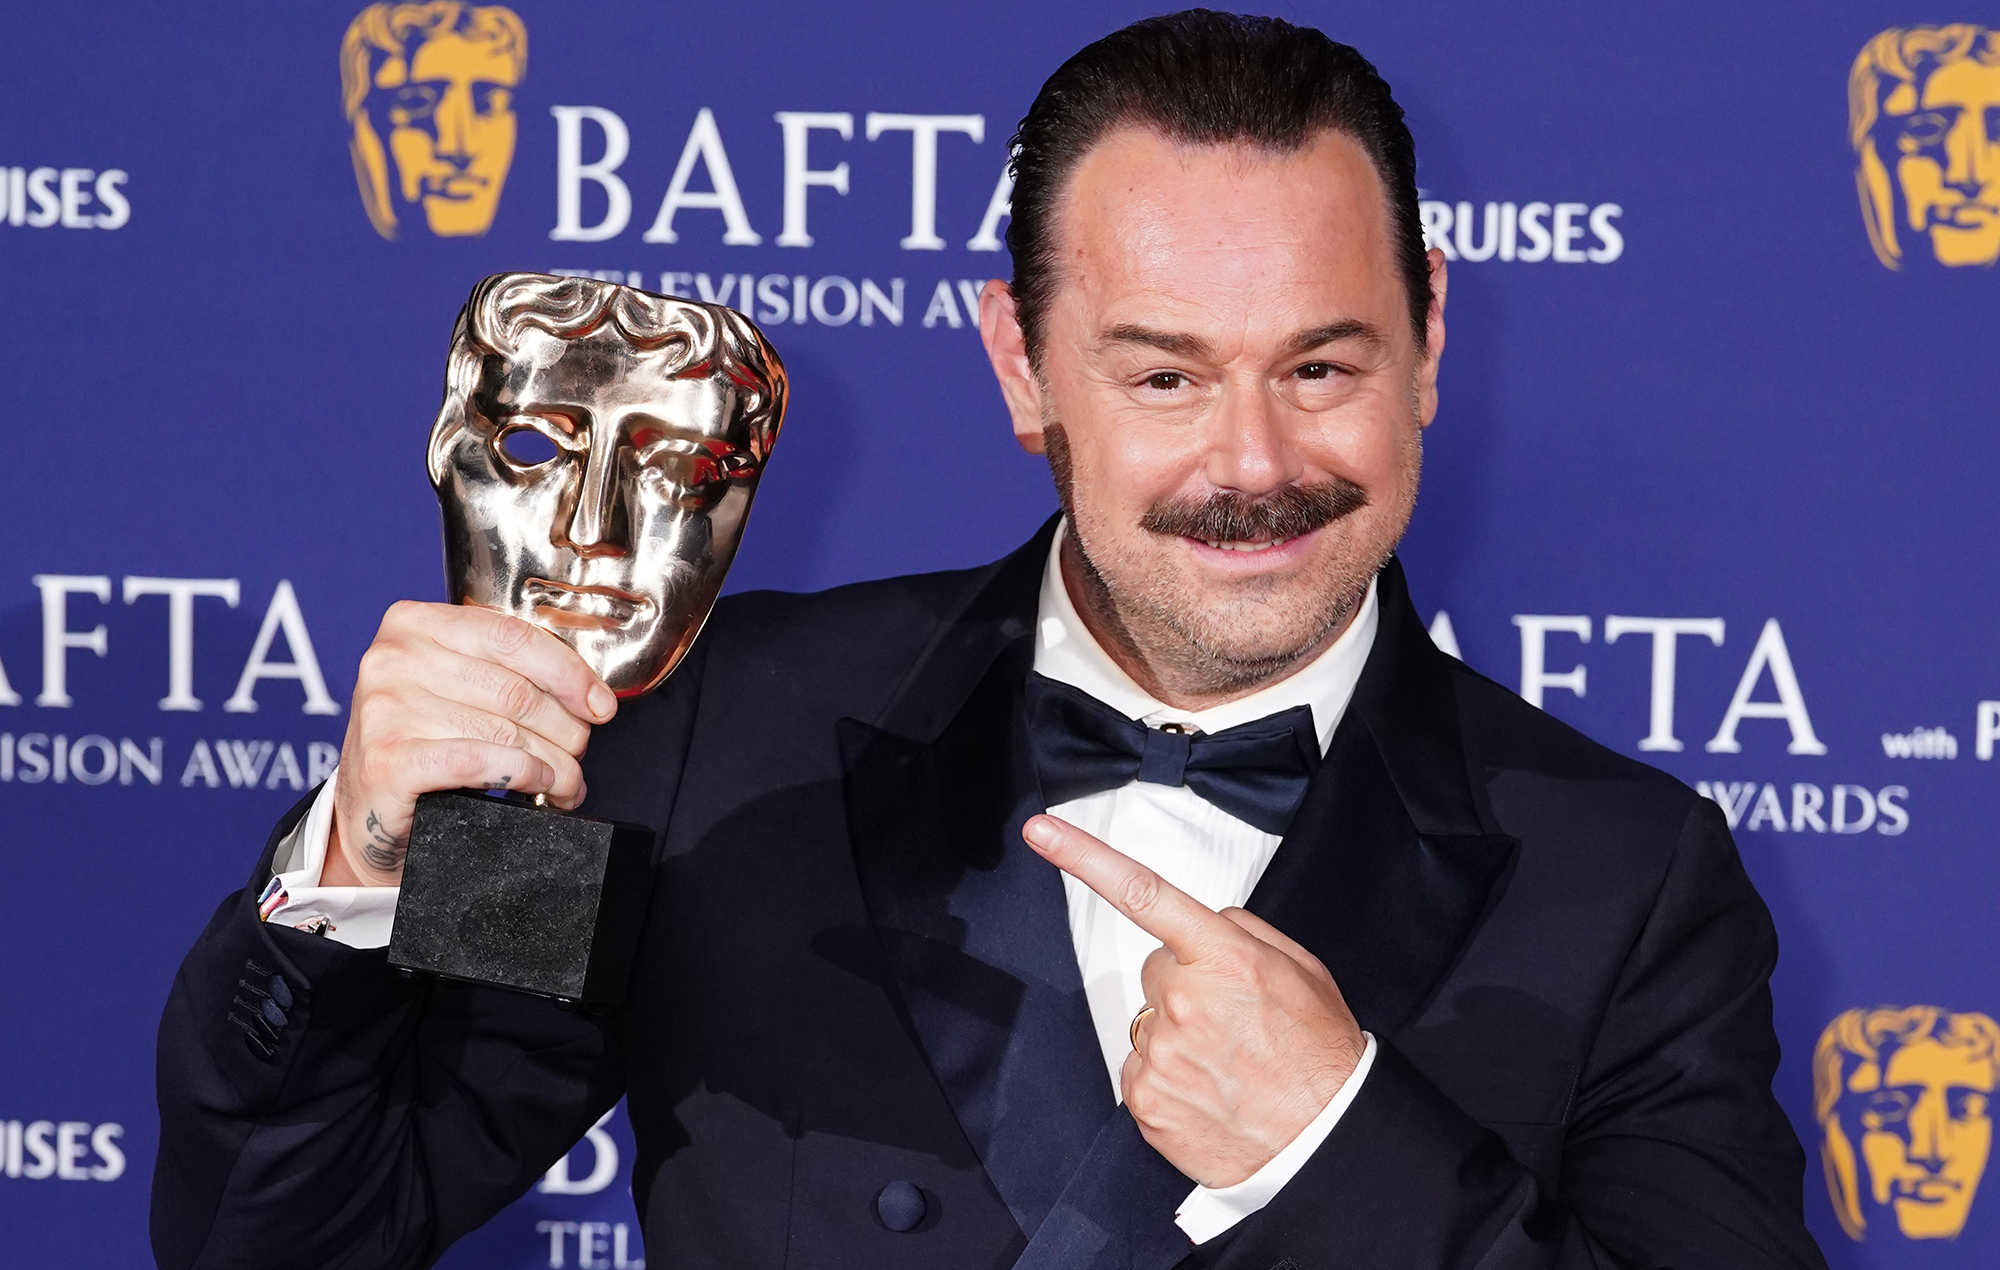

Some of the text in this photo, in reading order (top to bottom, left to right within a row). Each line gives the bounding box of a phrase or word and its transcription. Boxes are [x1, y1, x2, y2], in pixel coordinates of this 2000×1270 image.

[0, 165, 132, 231] ISES
[1418, 200, 1625, 265] RUISES
[0, 573, 343, 716] FTA
[1428, 610, 1828, 757] FTA
[1880, 725, 1959, 760] with
[0, 1118, 127, 1184] ISES
